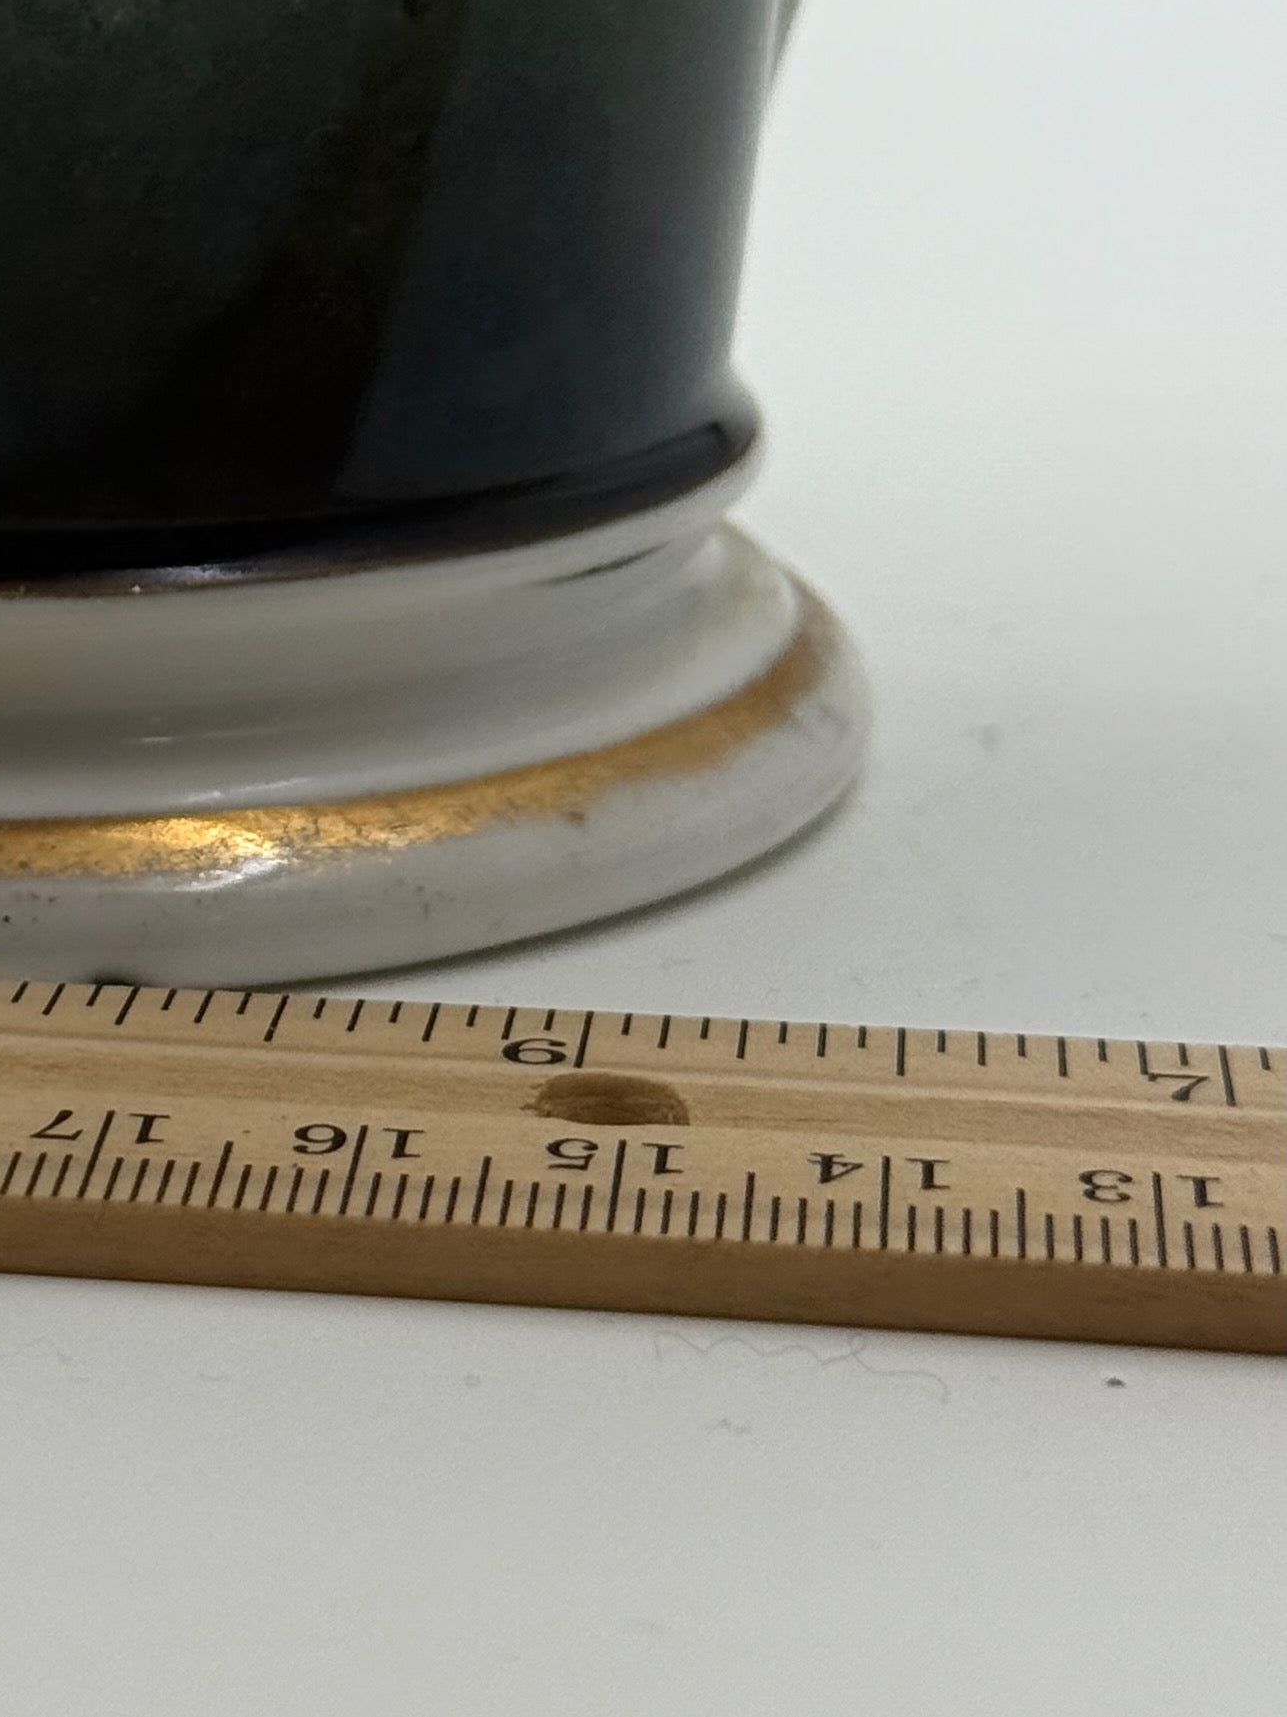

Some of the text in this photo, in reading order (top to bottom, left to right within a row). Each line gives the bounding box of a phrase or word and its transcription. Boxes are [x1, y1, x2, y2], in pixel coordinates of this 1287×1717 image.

[502, 1037, 567, 1065] 6
[1147, 1072, 1210, 1102] 7
[29, 1109, 172, 1144] 17
[292, 1123, 425, 1159] 16
[545, 1138, 685, 1176] 15
[807, 1152, 951, 1190] 14
[1078, 1169, 1223, 1209] 13
